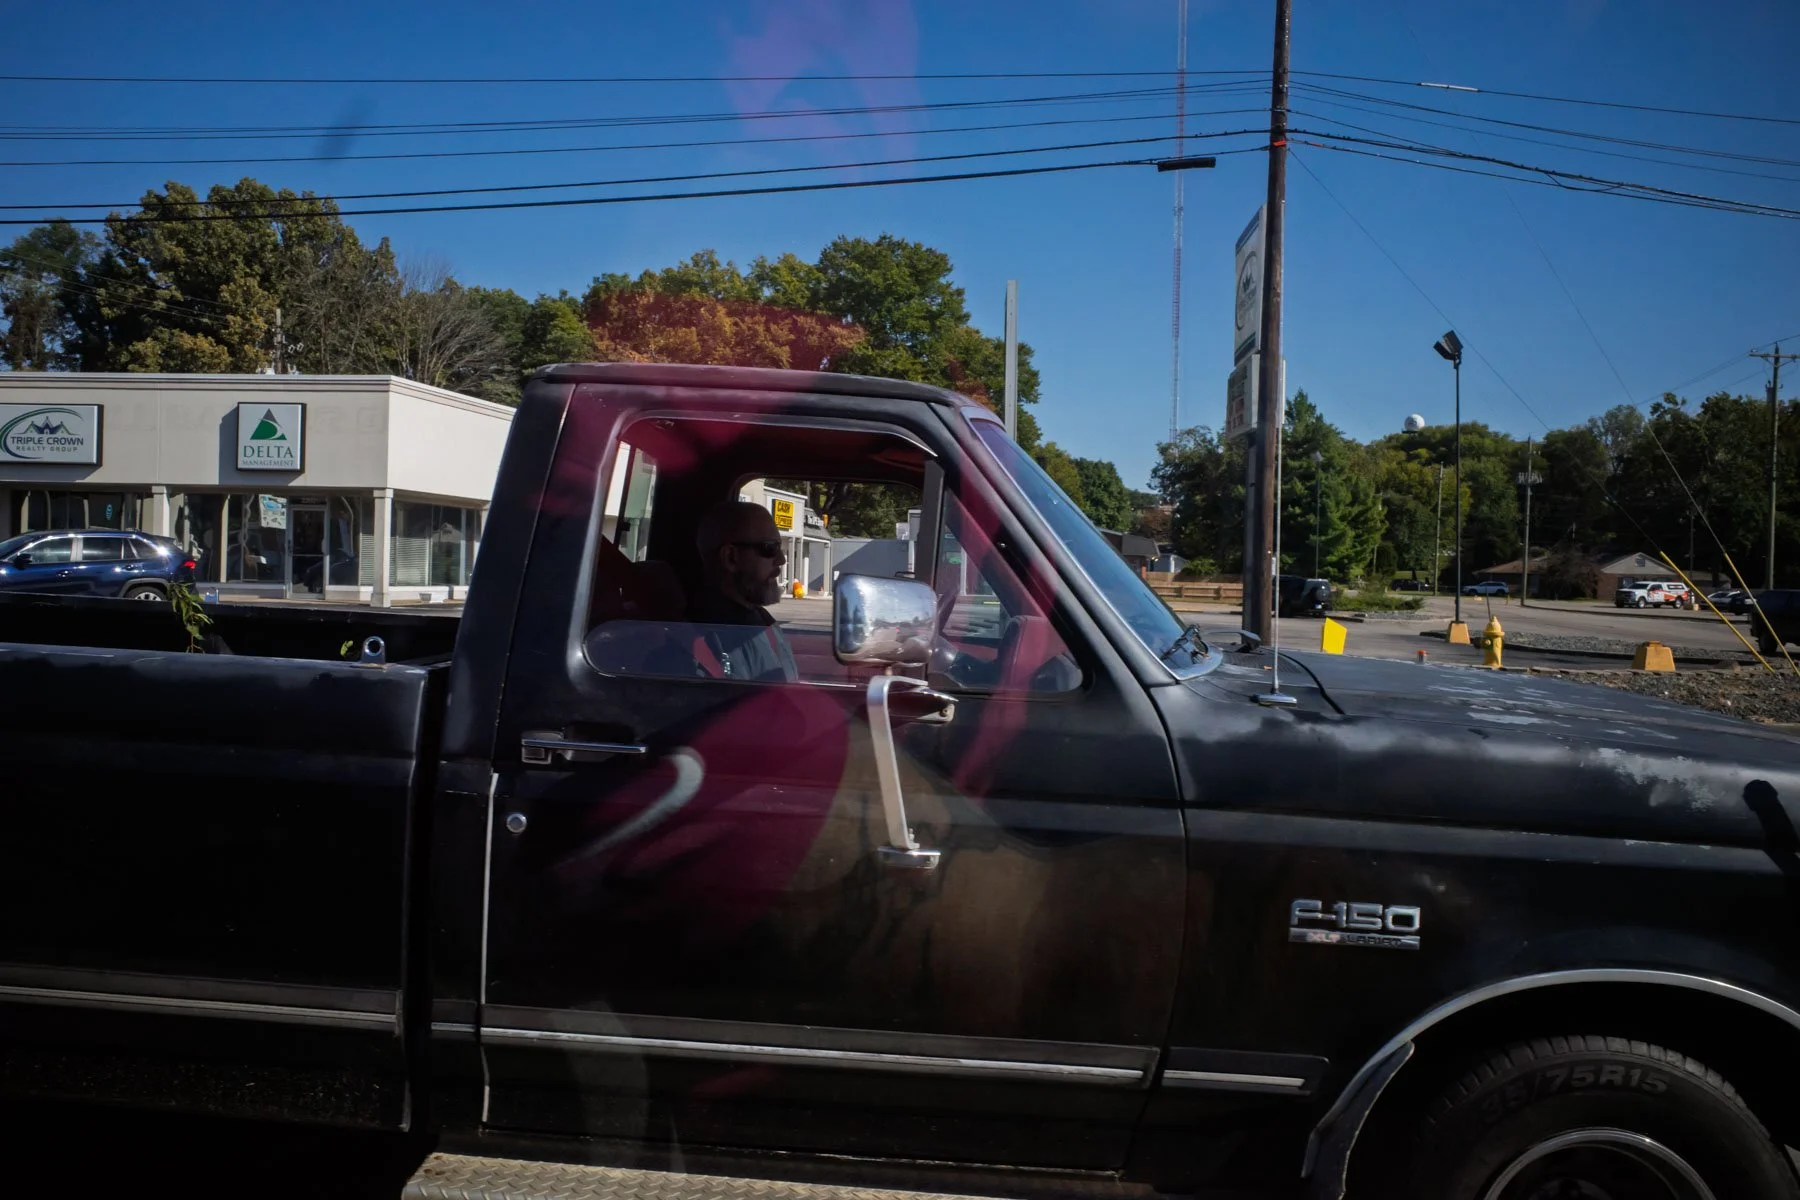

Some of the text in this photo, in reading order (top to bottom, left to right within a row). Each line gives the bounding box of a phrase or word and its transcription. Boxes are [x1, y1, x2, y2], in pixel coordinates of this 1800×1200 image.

[10, 436, 84, 446] TRIPLE CROWN
[243, 445, 294, 458] DELTA
[242, 459, 294, 467] MANAGEMENT
[777, 501, 791, 513] CASH
[1291, 899, 1421, 932] F-150
[1307, 932, 1340, 943] XLT
